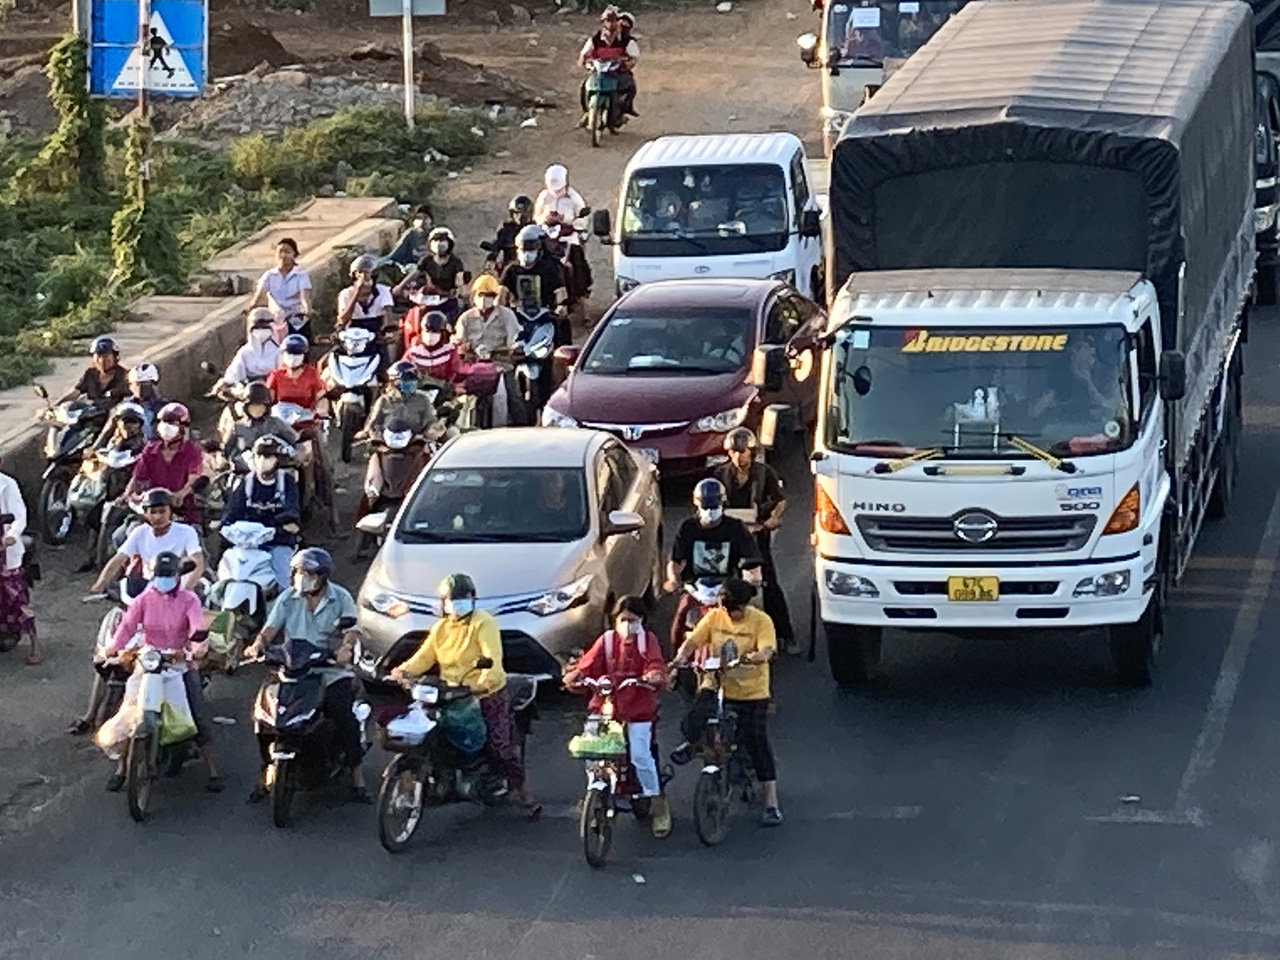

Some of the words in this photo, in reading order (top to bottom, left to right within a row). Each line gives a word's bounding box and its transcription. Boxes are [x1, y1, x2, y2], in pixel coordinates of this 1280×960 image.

[901, 330, 1069, 352] BRIDGESTONE
[852, 501, 906, 513] HINO
[1059, 501, 1101, 512] 500
